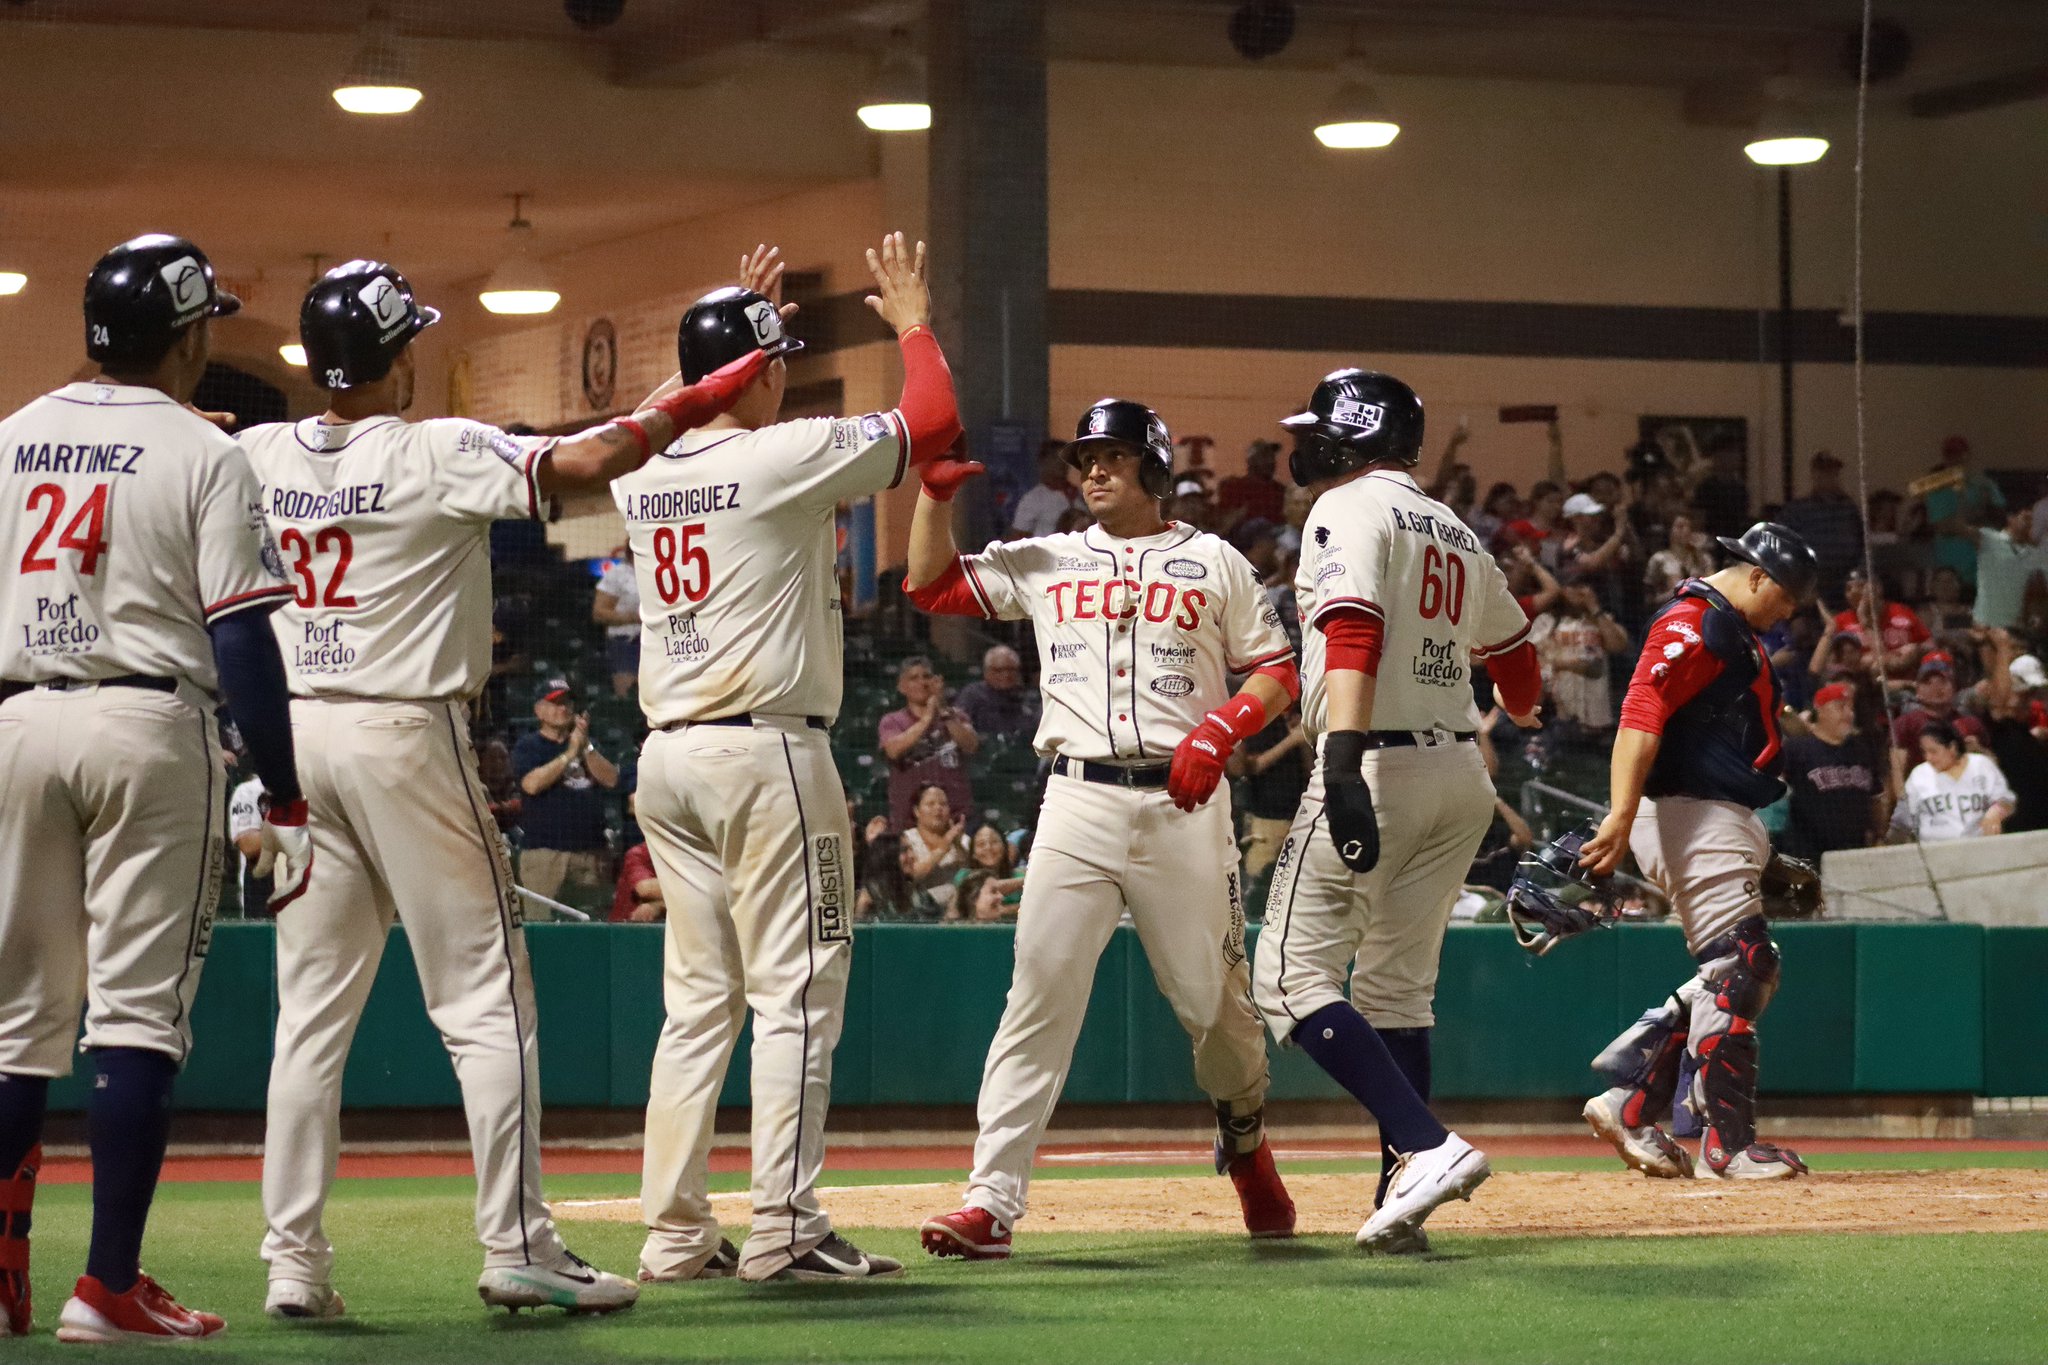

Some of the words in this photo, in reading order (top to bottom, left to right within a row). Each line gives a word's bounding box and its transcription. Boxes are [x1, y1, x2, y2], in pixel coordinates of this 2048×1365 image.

[93, 324, 110, 346] 24
[326, 368, 347, 388] 32
[14, 443, 145, 474] MARTINEZ
[627, 482, 740, 520] A.RODRIGUEZ
[20, 483, 108, 576] 24
[281, 526, 358, 608] 32
[653, 523, 711, 605] 85
[1419, 544, 1465, 626] 60
[37, 592, 79, 621] Port
[1045, 579, 1208, 631] TECOS
[23, 617, 100, 648] Laredo
[305, 617, 343, 643] Port
[668, 611, 697, 635] Port
[295, 642, 355, 667] Laredo
[664, 632, 709, 656] Laredo
[1057, 643, 1087, 652] FALCON
[1057, 651, 1077, 659] BANK
[1422, 637, 1456, 660] Port
[1413, 656, 1462, 681] Laredo
